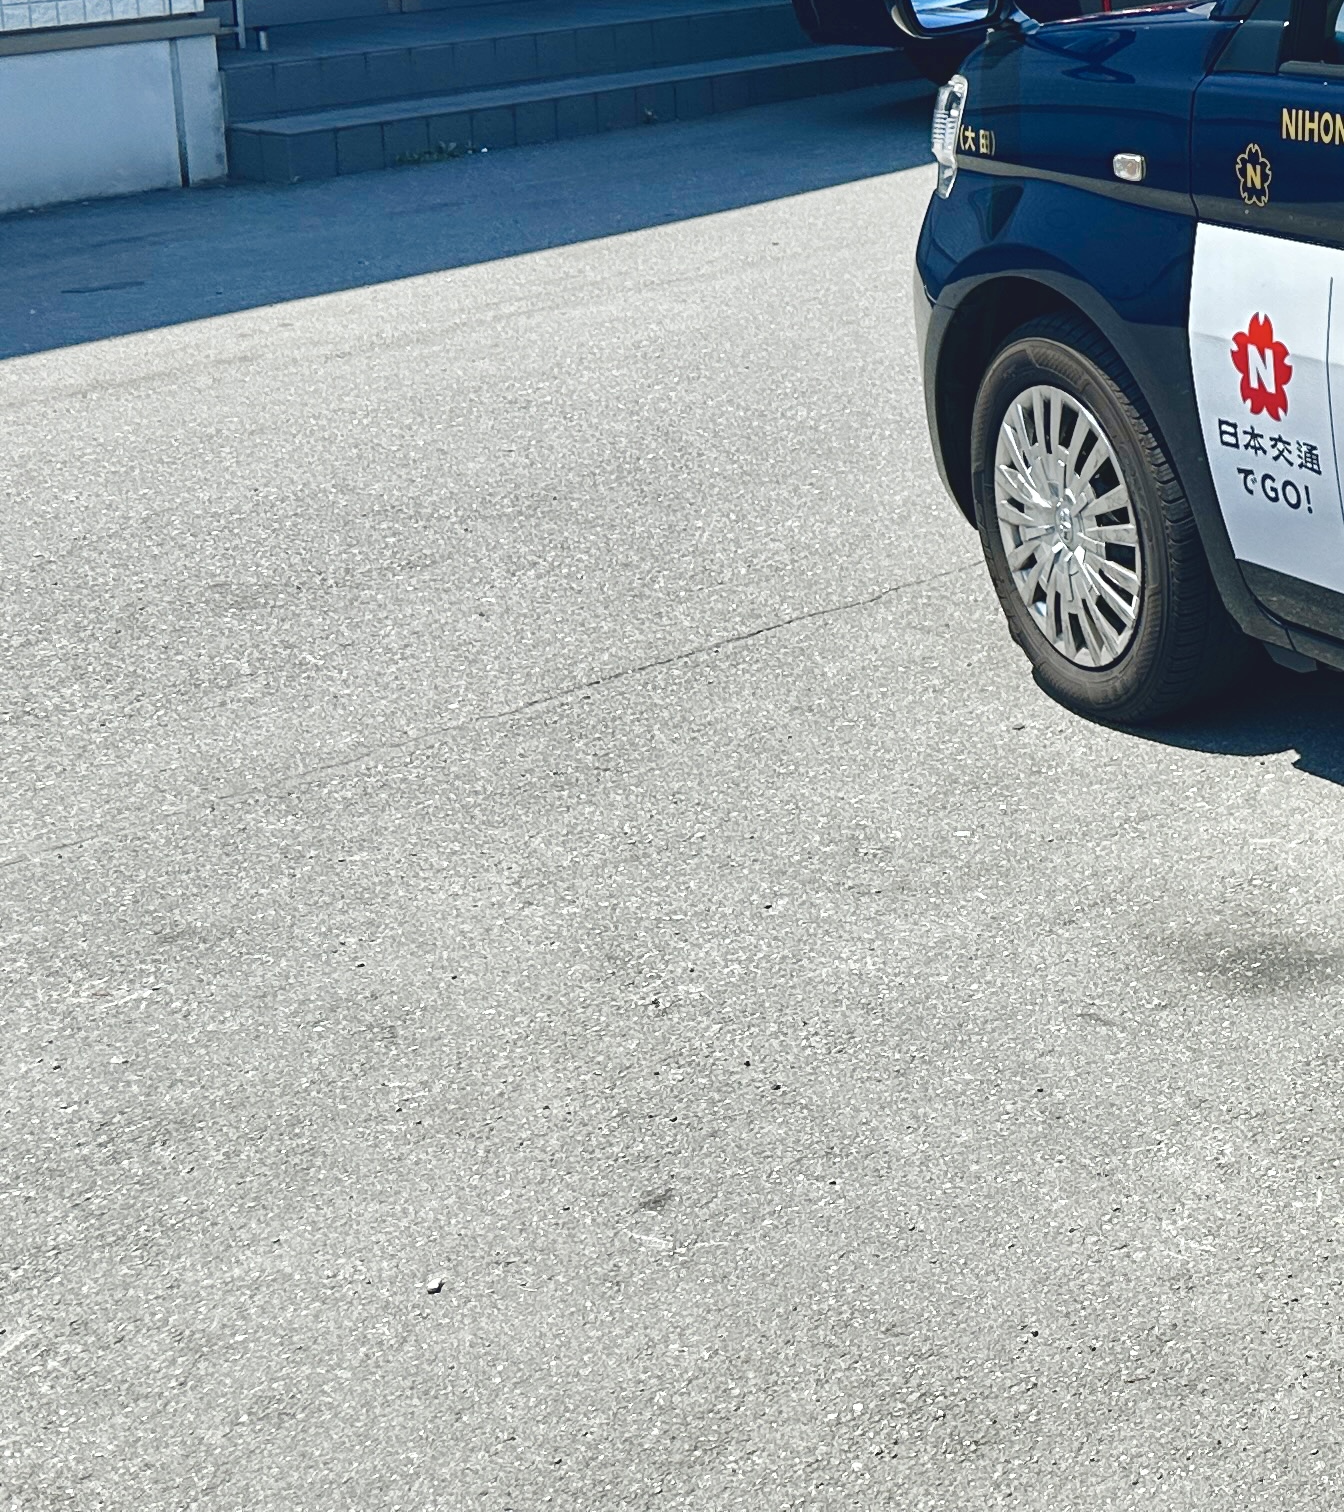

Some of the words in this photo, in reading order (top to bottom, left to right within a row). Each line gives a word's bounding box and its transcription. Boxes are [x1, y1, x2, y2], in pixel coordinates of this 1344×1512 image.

[1246, 162, 1261, 189] N
[1246, 343, 1277, 394] N
[1217, 418, 1323, 476] 日本交通
[1237, 467, 1314, 515] でGO!
